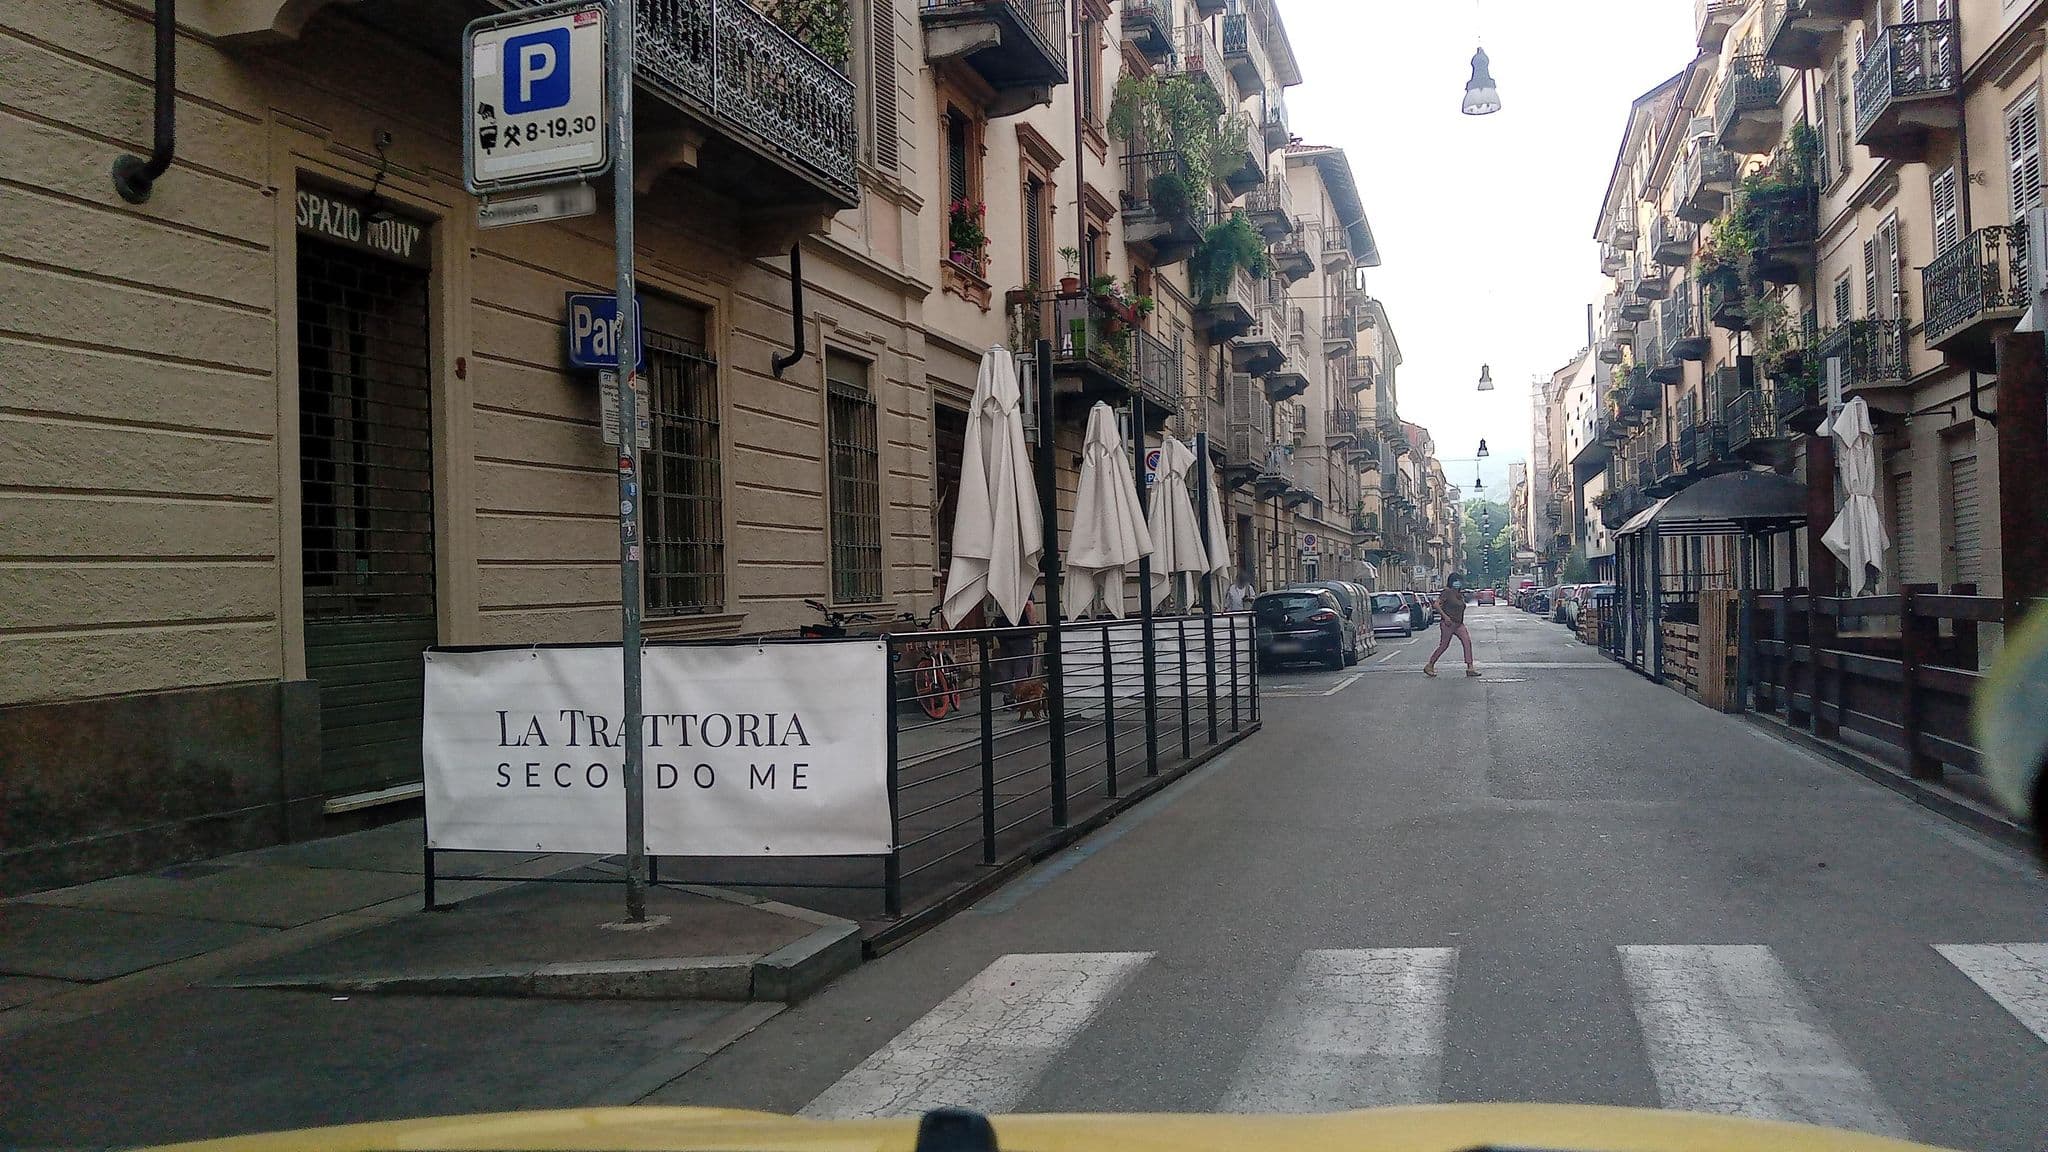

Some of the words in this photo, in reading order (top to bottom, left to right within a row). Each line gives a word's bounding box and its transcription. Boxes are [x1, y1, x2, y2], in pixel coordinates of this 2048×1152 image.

[520, 42, 556, 102] P
[526, 115, 596, 142] 8-19,30
[296, 191, 361, 242] SPAZIO
[496, 710, 549, 747] LA
[496, 763, 715, 789] SECODO
[750, 763, 809, 790] ME
